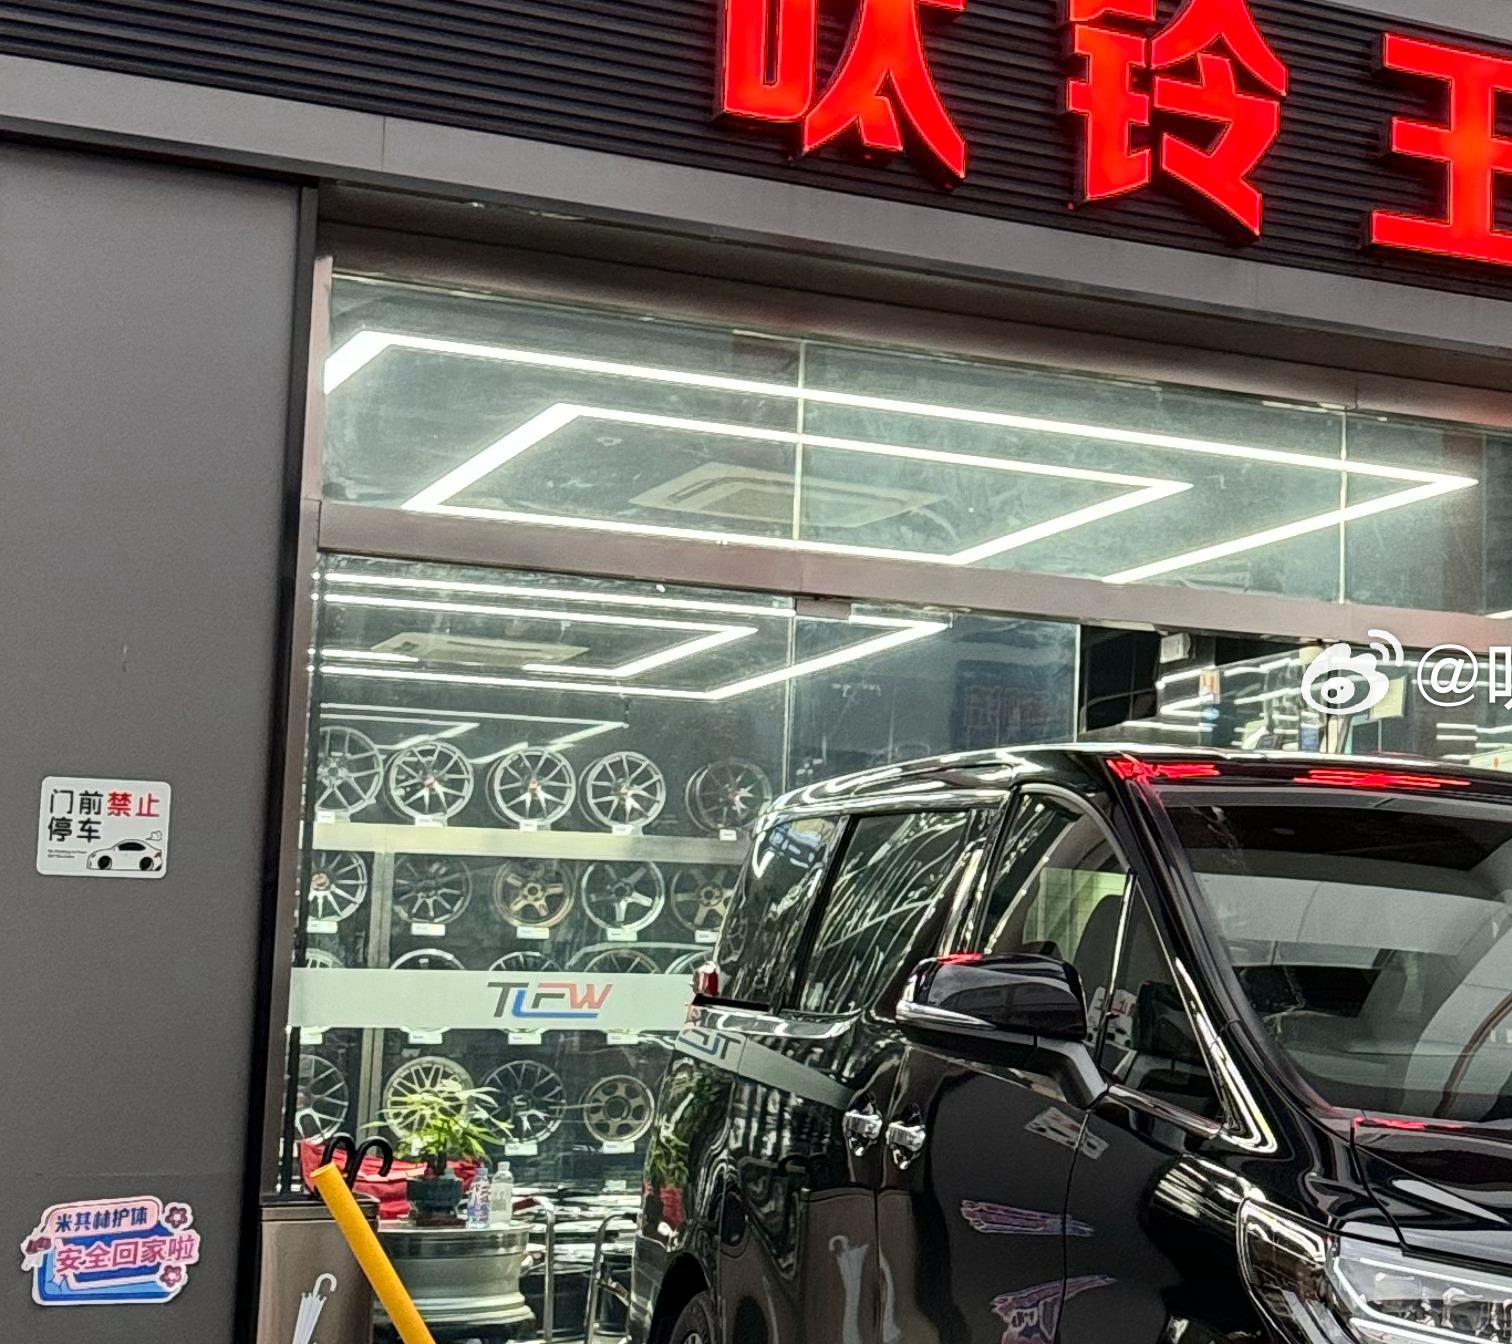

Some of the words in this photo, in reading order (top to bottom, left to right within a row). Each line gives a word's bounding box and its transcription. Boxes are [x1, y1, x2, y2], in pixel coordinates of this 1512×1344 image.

[50, 788, 160, 818] 门前禁止
[47, 816, 102, 843] 停车
[56, 1234, 196, 1274] 安全回家啦
